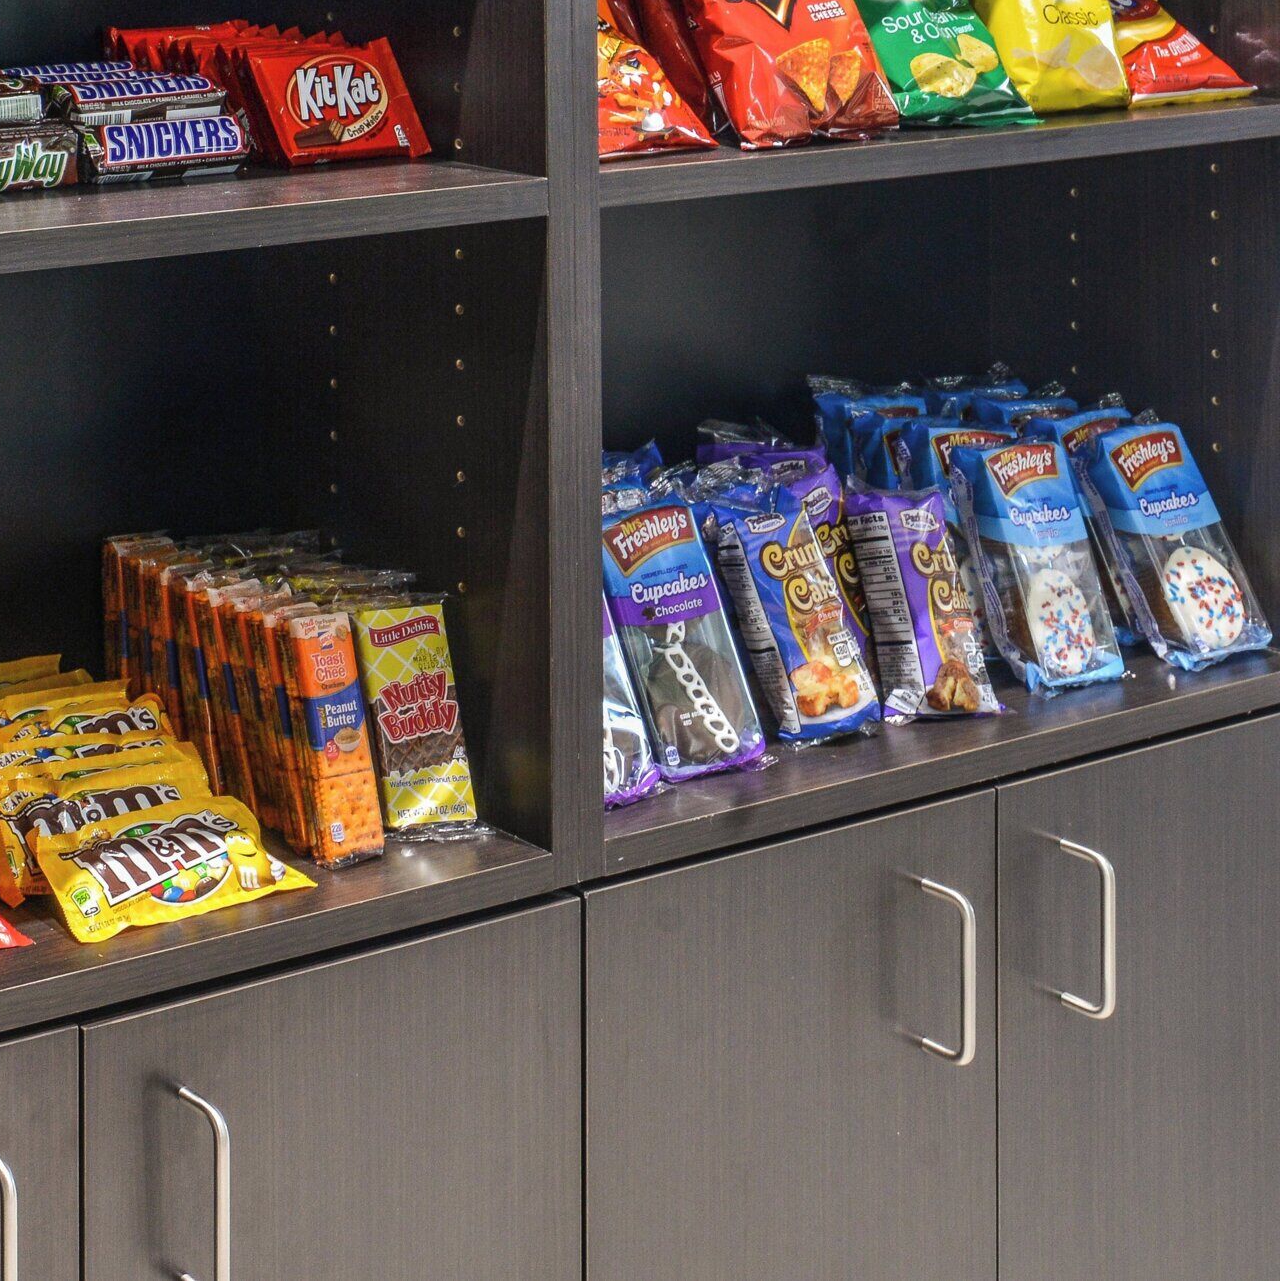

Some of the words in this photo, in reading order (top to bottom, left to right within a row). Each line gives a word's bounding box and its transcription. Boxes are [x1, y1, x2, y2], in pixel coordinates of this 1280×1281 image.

[807, 1, 839, 13] NACHO
[810, 7, 846, 22] CHEESE
[1042, 4, 1098, 27] Classic
[881, 6, 923, 34] Sour
[912, 27, 924, 44] &
[78, 75, 208, 100] SNICKERS
[346, 125, 365, 139] Crisp
[364, 110, 383, 132] Wafers
[107, 118, 238, 162] SNICKERS
[1118, 440, 1176, 474] Freshley's
[993, 452, 1053, 486] Freshley's
[1010, 504, 1070, 525] Cupcakes
[1139, 493, 1198, 516] Cupcakes
[613, 512, 688, 555] Freshley's
[621, 518, 643, 534] Mrs.
[631, 573, 709, 605] Cupcakes
[655, 597, 703, 618] Chocolate
[374, 629, 400, 644] Little
[404, 620, 434, 635] Debbie
[312, 652, 345, 667] Toast
[315, 666, 346, 682] Chee
[380, 671, 446, 710] Nutty
[325, 700, 357, 715] Peanut
[327, 714, 356, 728] Butter
[378, 700, 458, 743] Buddy
